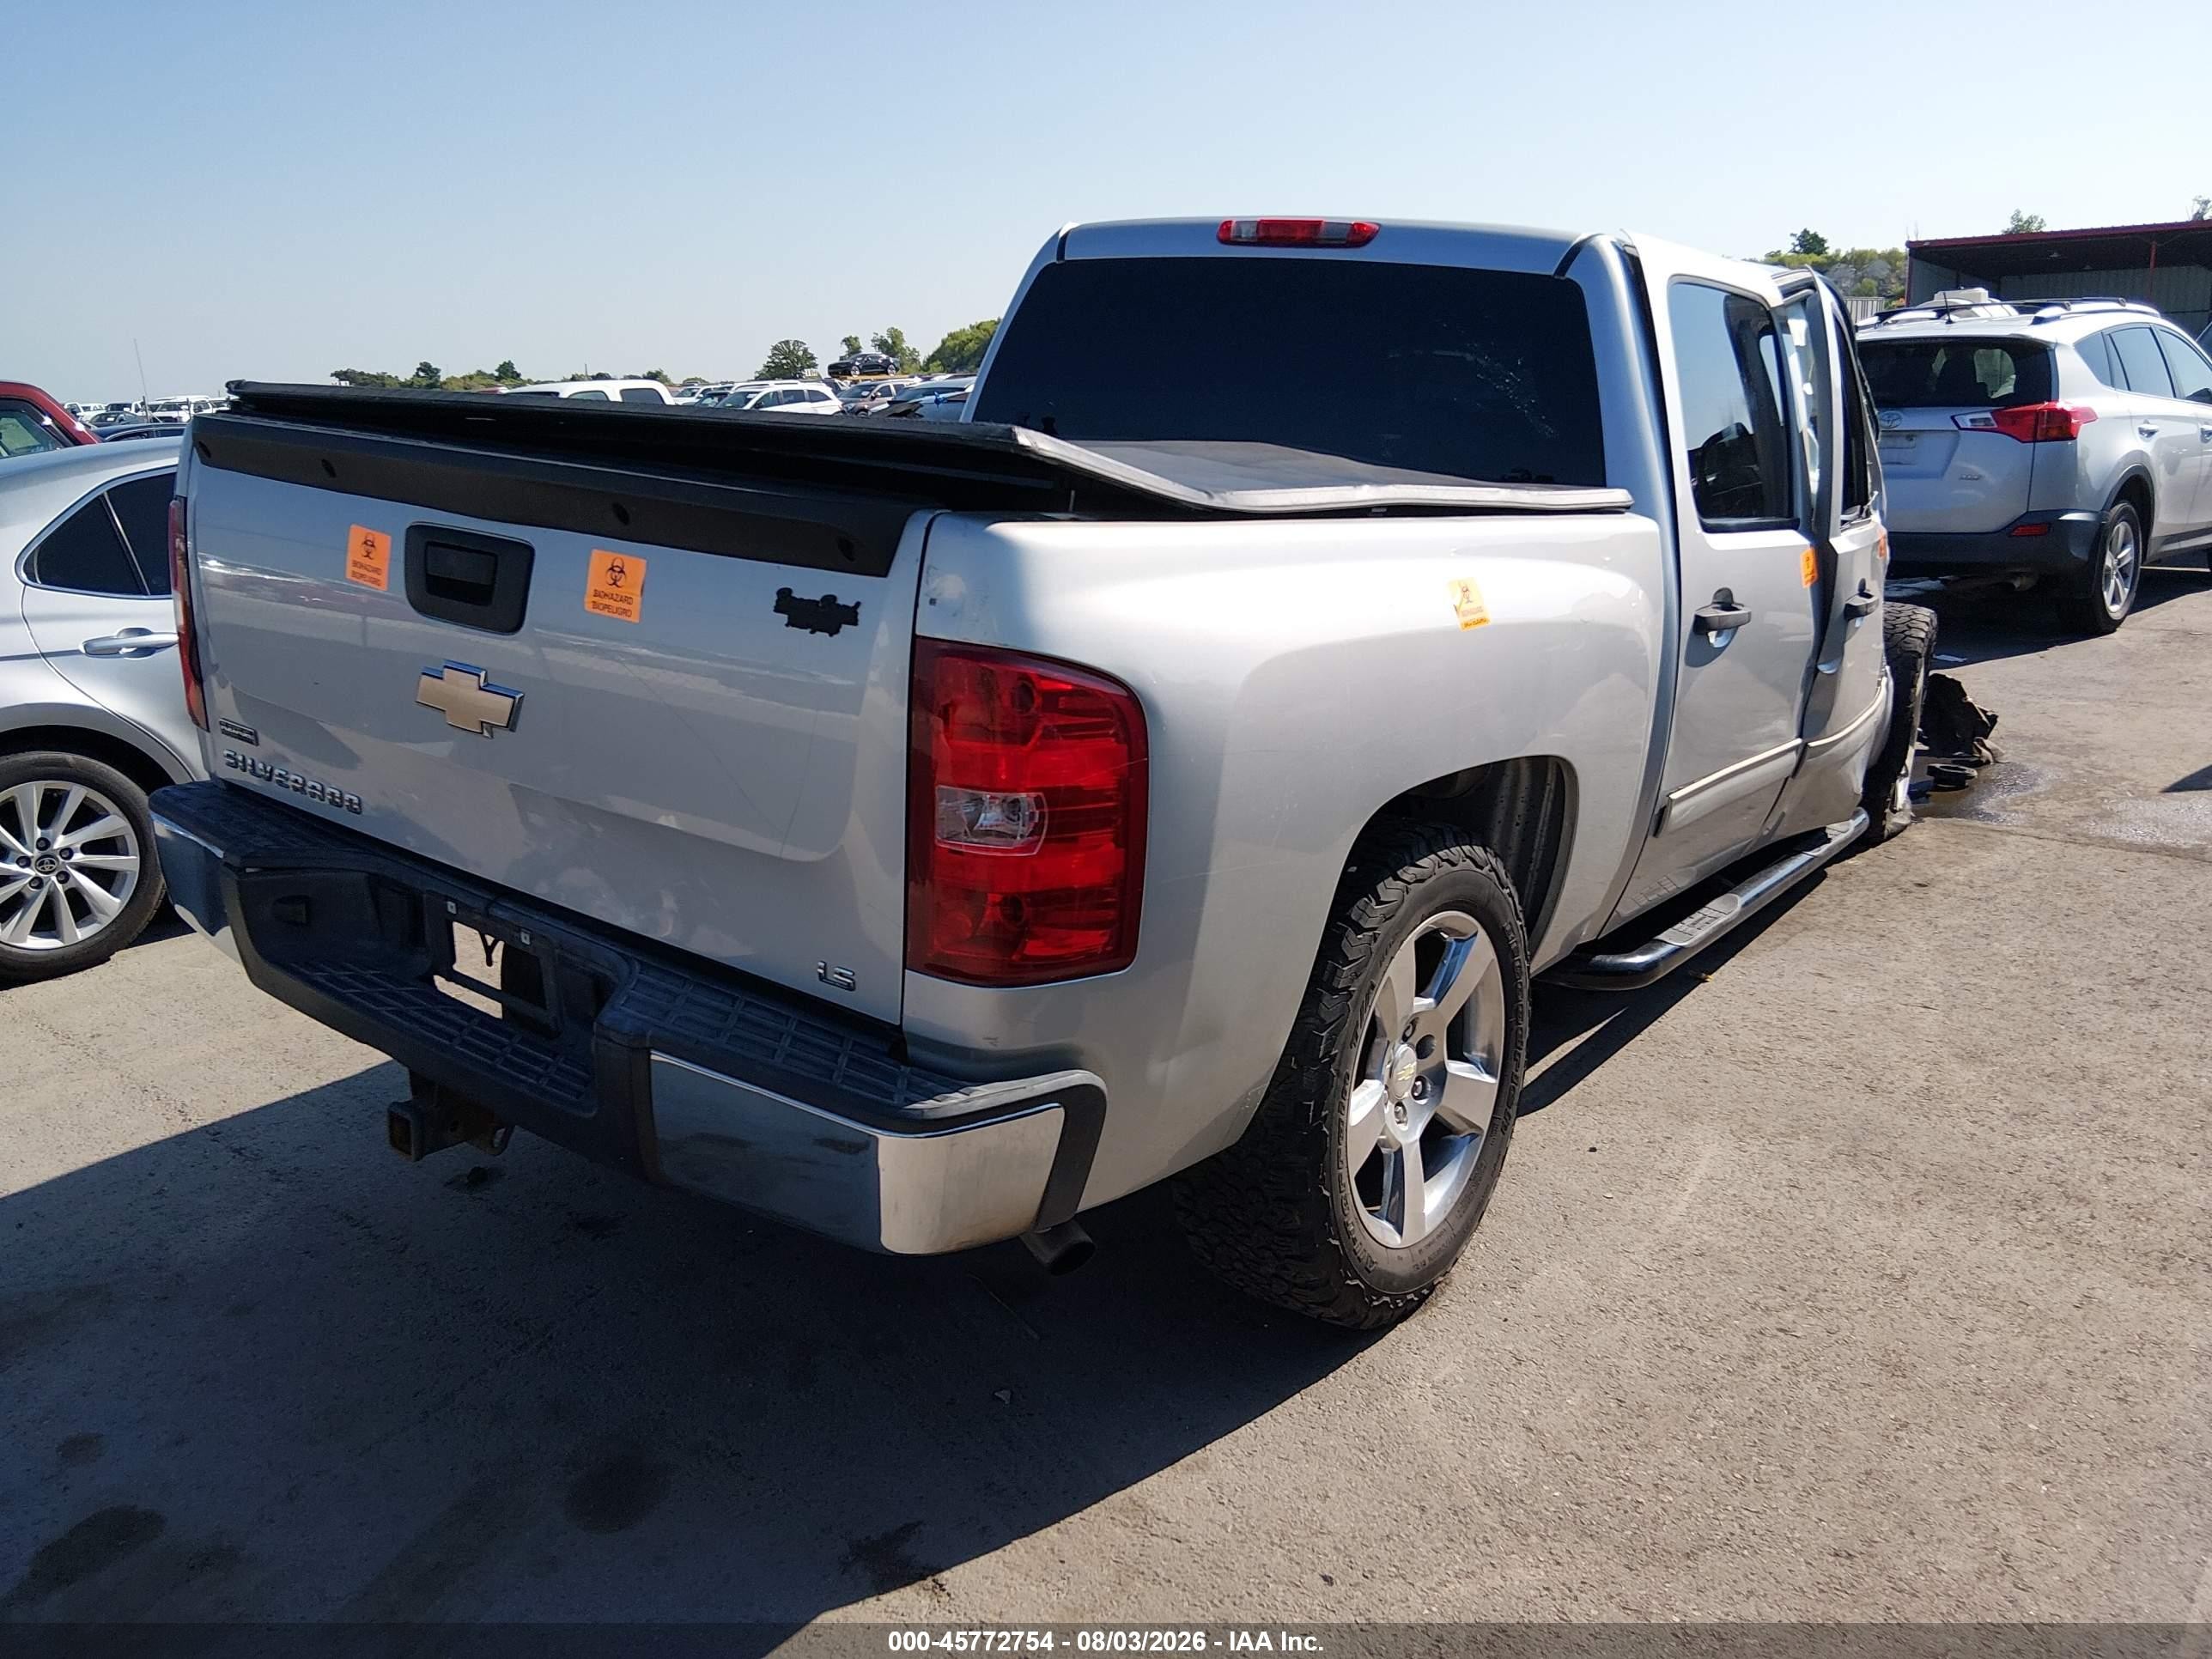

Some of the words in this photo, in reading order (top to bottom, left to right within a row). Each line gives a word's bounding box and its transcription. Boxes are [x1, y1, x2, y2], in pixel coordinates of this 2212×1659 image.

[591, 600, 633, 617] BIOPELIGRO
[592, 589, 634, 605] BIOHAZARD
[222, 748, 362, 815] SILVERADO
[817, 960, 857, 992] LS
